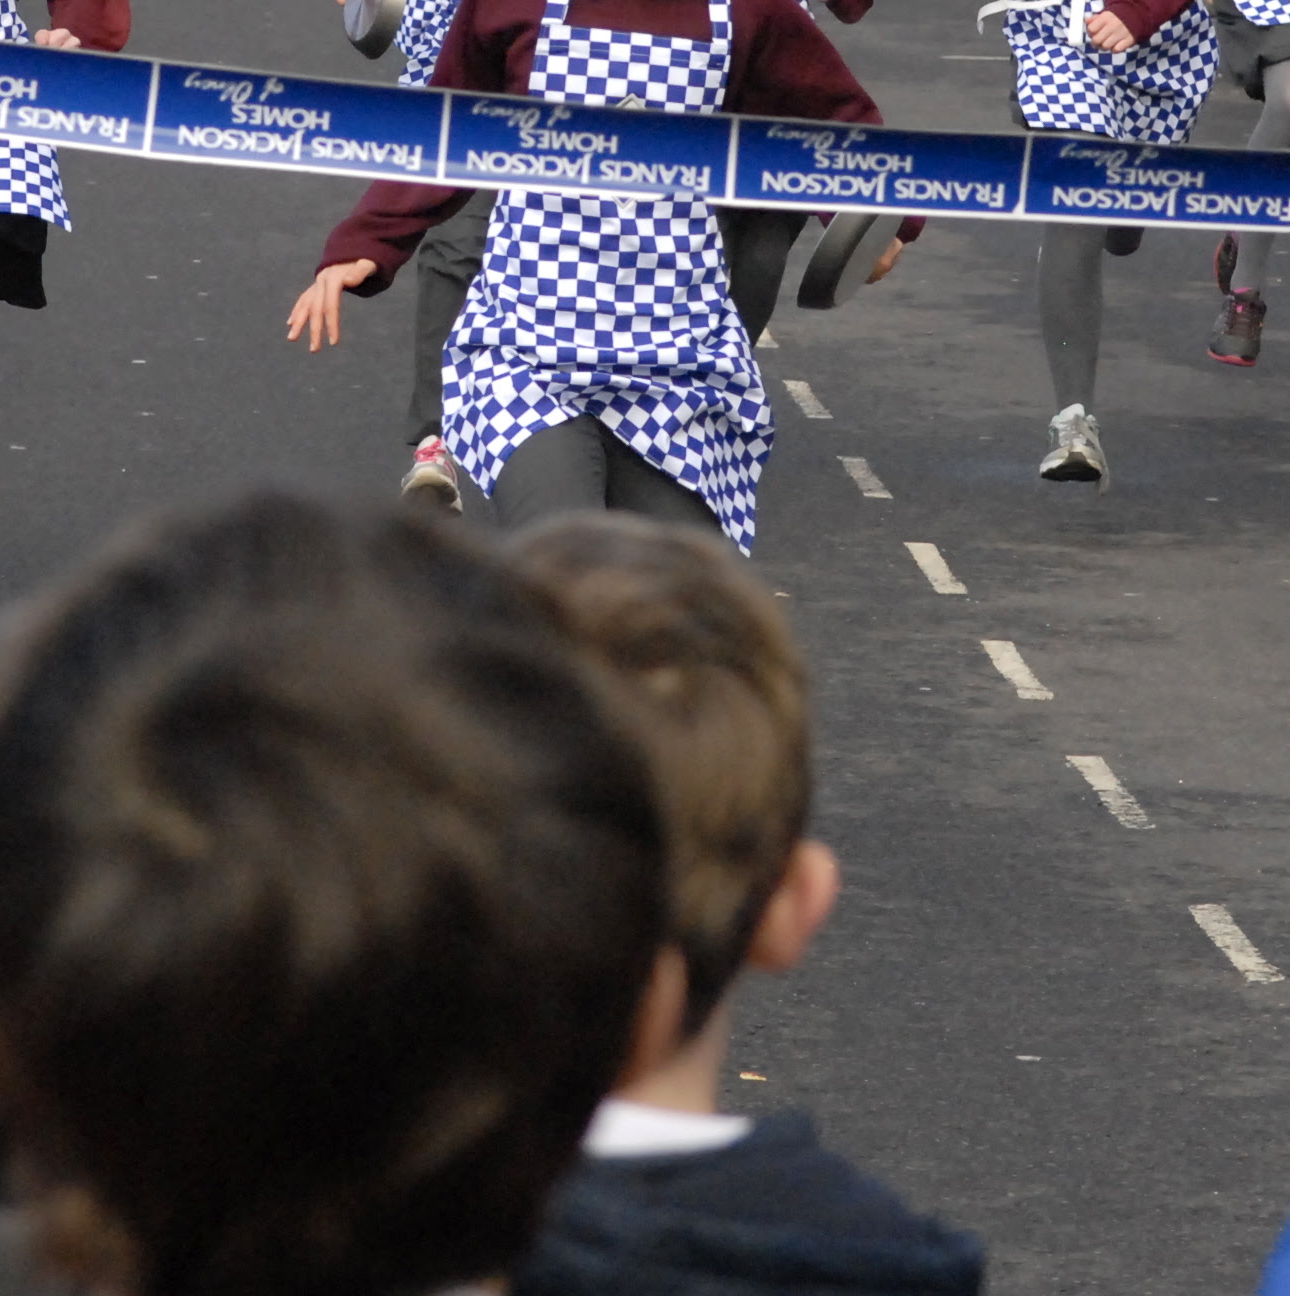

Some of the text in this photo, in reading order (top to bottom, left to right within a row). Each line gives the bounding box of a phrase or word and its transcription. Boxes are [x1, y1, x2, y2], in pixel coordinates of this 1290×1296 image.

[183, 71, 283, 103] of Olney
[16, 107, 129, 143] FRANCIS
[231, 101, 330, 131] HOMES
[177, 124, 422, 171] FRANCIS JACKSON
[519, 126, 617, 154] HOMES
[466, 149, 711, 192] FRANCIS JACKSON
[813, 148, 912, 172] HOMES
[761, 169, 1005, 208] FRANCIS JACKSON
[1106, 165, 1204, 188] HOMES
[1052, 185, 1178, 216] JACKSON
